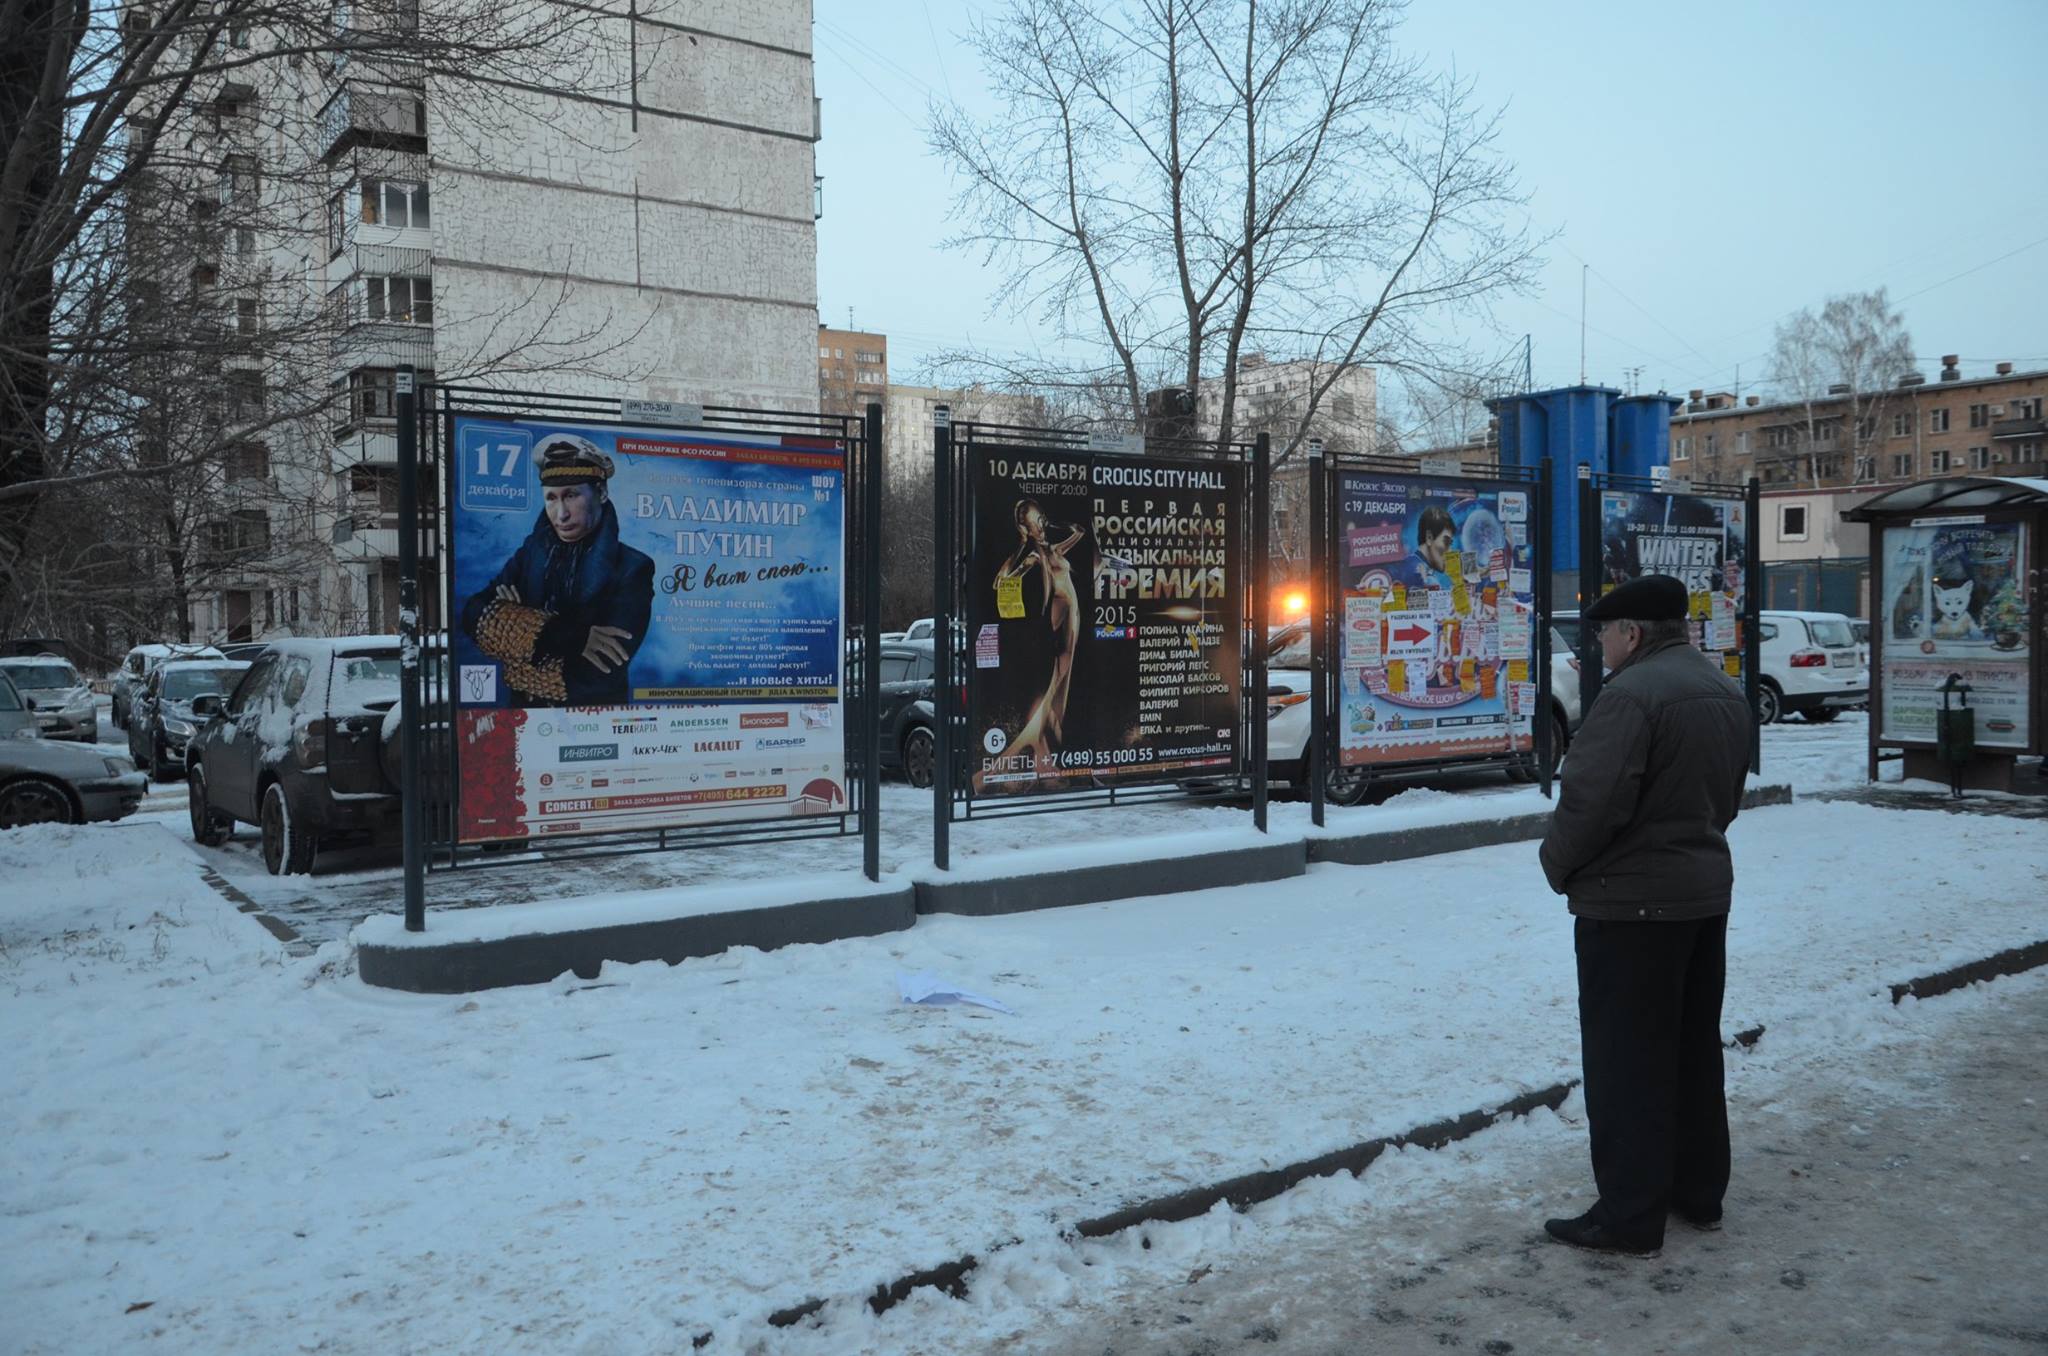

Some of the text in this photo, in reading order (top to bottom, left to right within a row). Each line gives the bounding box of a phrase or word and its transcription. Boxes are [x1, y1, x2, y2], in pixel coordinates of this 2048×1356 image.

[622, 442, 637, 451] ПРИ
[637, 443, 680, 455] ПОДДЕРЖКЕ
[681, 447, 698, 457] ФСО
[698, 448, 727, 458] РОССИИ
[474, 443, 523, 477] 17
[988, 459, 1087, 480] 10 ДЕКАБРЯ
[696, 477, 764, 491] телевизорах
[766, 480, 805, 492] страны
[811, 475, 836, 488] ШОУ
[1092, 466, 1226, 489] CROCUS CITY HALL
[467, 484, 526, 499] декабря
[814, 489, 830, 502] №1
[1018, 482, 1088, 496] ЧЕТВЕРГ 20:00
[635, 492, 808, 526] ВЛАДИМИР
[1093, 498, 1226, 516] ПЕРВАЯ
[1352, 502, 1363, 512] 19
[1364, 501, 1406, 515] ДЕКАБРЯ
[1093, 514, 1226, 536] РОССИЙСКАЯ
[674, 530, 775, 558] ПУТИН
[1352, 534, 1398, 546] РОССИЙСКАЯ
[1353, 545, 1399, 559] ПРЕМЬЕРА!
[1637, 535, 1718, 567] WINTER
[661, 563, 697, 594] Я
[703, 563, 751, 589] вам
[1093, 567, 1226, 600] ПРЕМИЯ
[670, 597, 721, 610] Лучшие
[1094, 606, 1137, 625] 2015
[1096, 626, 1135, 639] РОССИЯ 1
[1139, 626, 1178, 636] ПОЛИНА
[1139, 636, 1181, 648] ВАЛЕРИЙ
[1139, 649, 1200, 662] ДИМА БИЛАН
[1139, 660, 1186, 673] ГРИГОРИЙ
[751, 675, 794, 685] новые
[797, 673, 833, 685] хиты!
[1139, 673, 1185, 685] НИКОЛАЙ
[648, 687, 729, 697] ИНФОРМАЦИОННЫЙ
[730, 689, 763, 697] ПАРТНЕР
[768, 688, 789, 697] JULIA
[1139, 687, 1180, 698] ФИЛИПП
[1139, 699, 1179, 710] ВАЛЕРИЯ
[669, 717, 729, 728] ANDERSSEN
[1139, 713, 1162, 723] EMIN
[611, 723, 658, 735] ТЕЛЕКАРТА
[693, 740, 743, 753] LACALUT
[991, 734, 1005, 748] 6+
[563, 746, 613, 759] ИНВИТРО
[982, 742, 1232, 772] БИЛЕТЫ +7 (499) 55 000 55 www.crocus-hall.ru
[725, 788, 750, 800] 644
[753, 785, 784, 798] 2222
